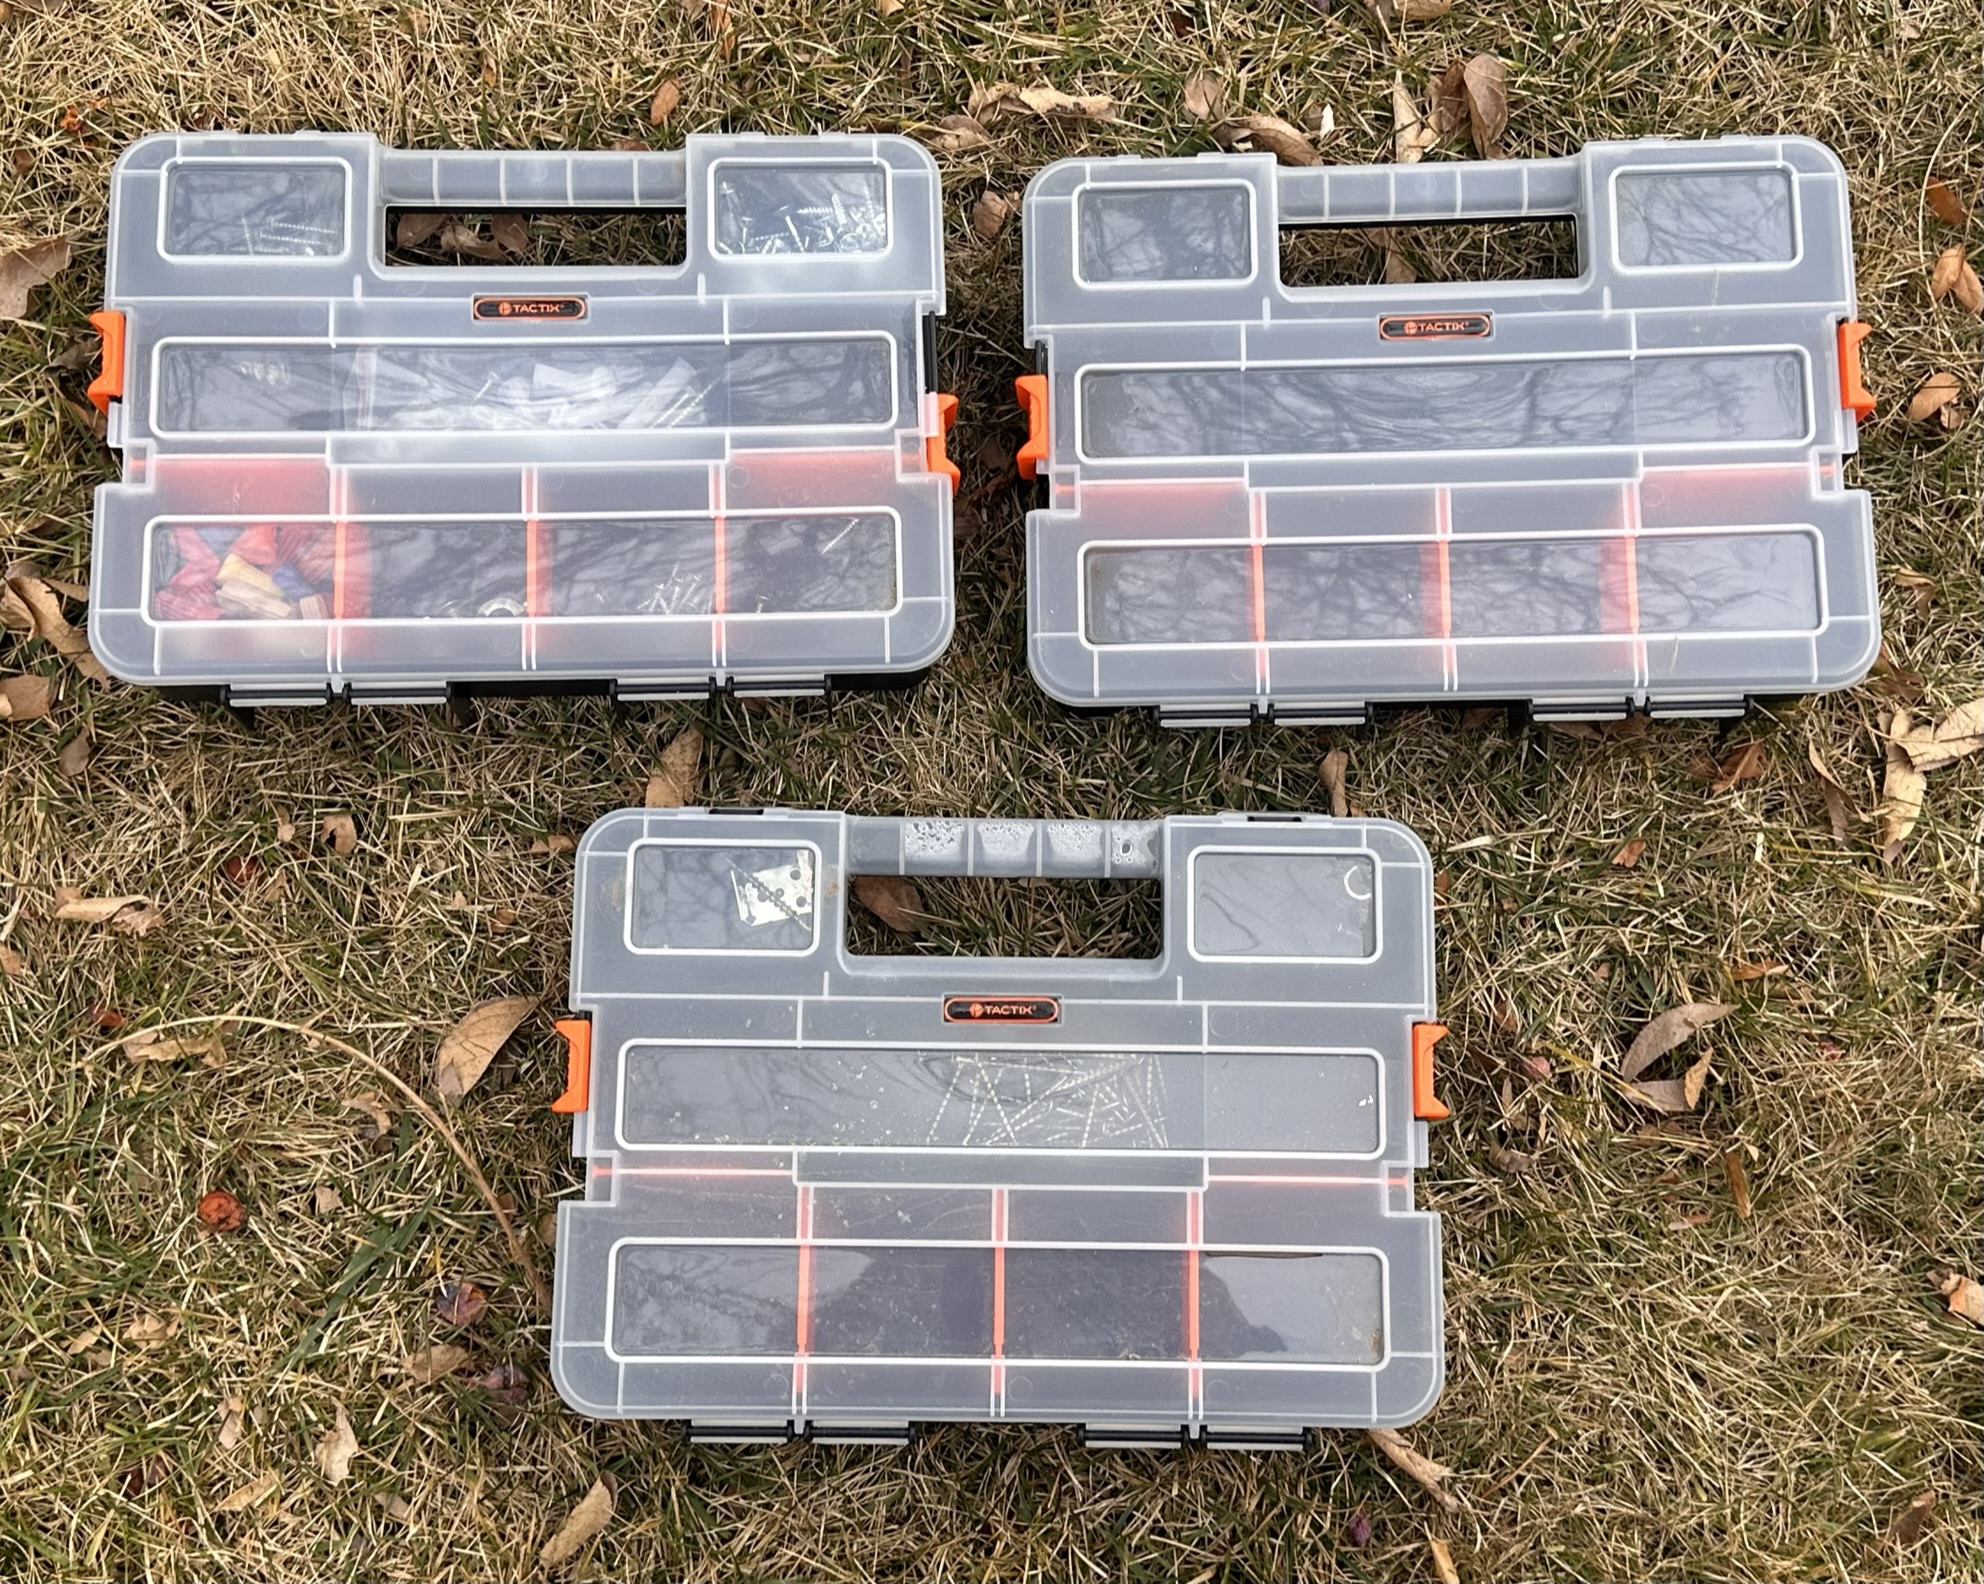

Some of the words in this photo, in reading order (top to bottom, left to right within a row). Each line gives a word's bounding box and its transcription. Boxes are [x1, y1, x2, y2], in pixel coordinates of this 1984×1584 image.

[512, 304, 560, 313] TACTIX
[1419, 322, 1465, 332] TACTIX
[984, 1005, 1032, 1015] TACTIX
